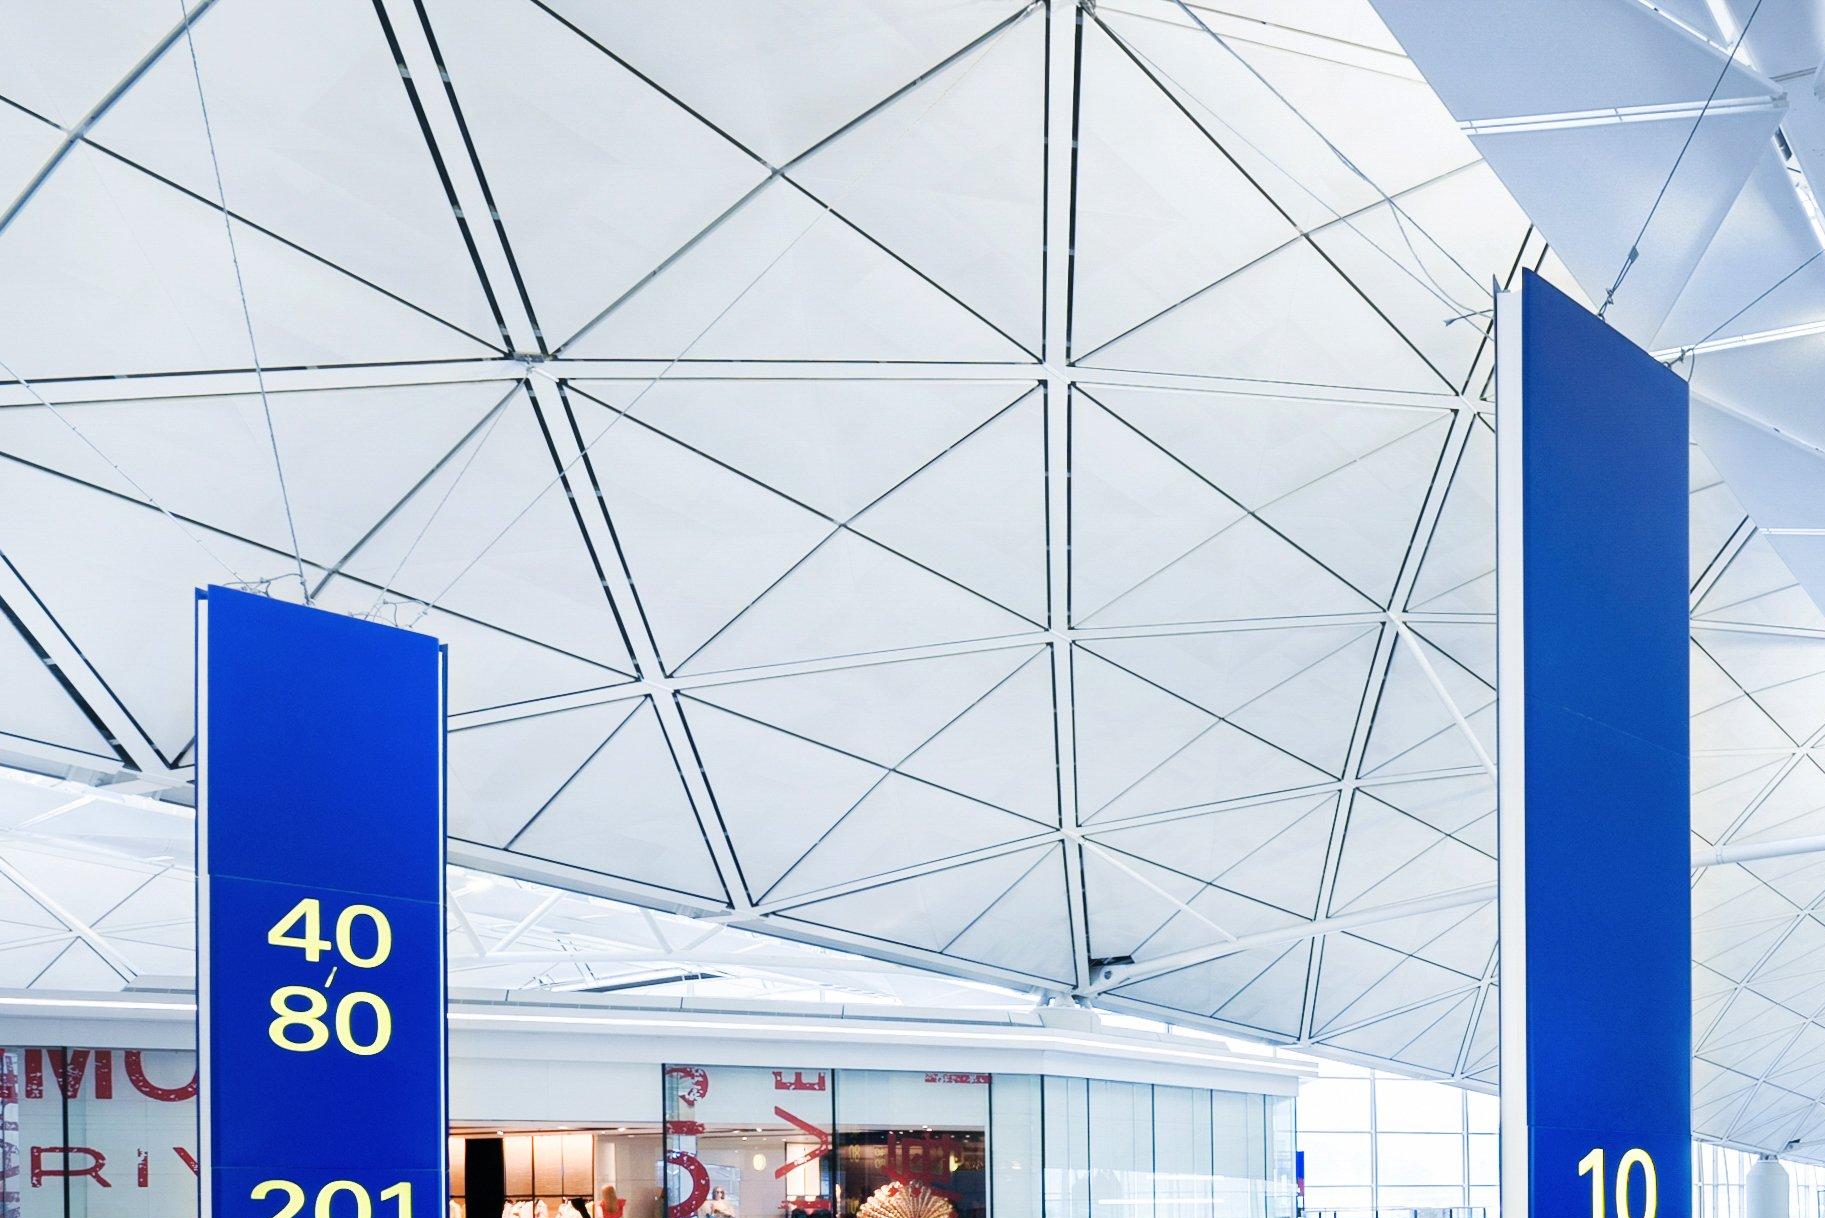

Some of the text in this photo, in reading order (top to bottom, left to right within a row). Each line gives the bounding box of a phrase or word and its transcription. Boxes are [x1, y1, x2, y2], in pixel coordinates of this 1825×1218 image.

[268, 897, 392, 969] 40
[268, 986, 392, 1056] 80
[30, 1146, 198, 1188] RI
